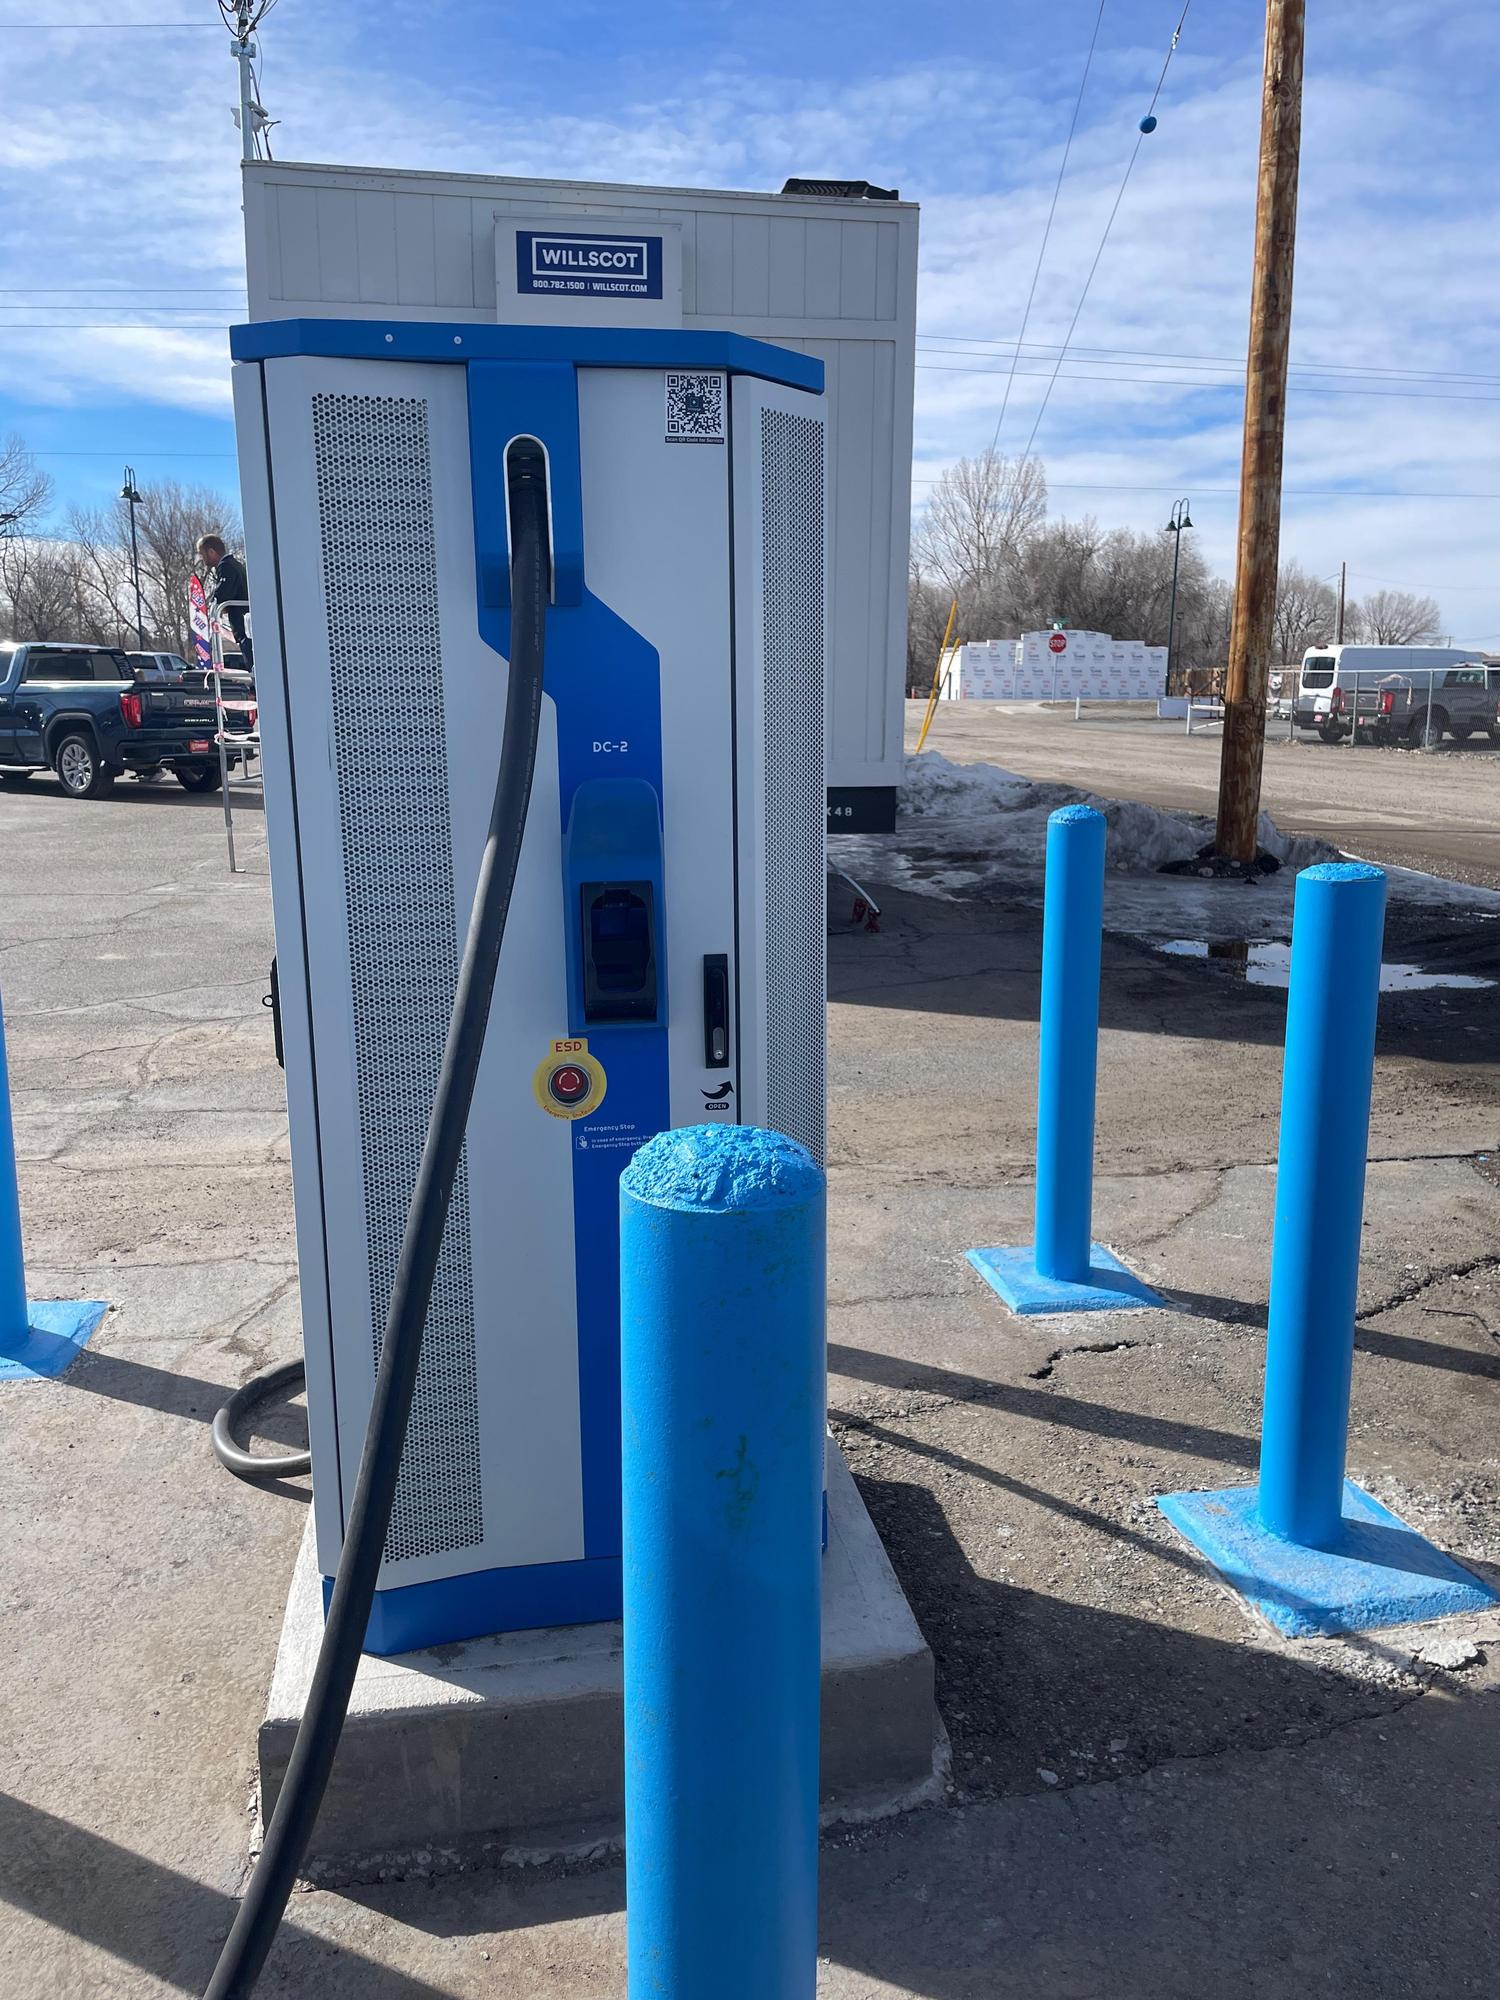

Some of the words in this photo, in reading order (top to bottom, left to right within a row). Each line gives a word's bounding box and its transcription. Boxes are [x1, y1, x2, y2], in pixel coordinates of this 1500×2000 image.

[542, 249, 638, 268] WILLSCOT
[532, 279, 585, 290] 800.782.1500
[592, 282, 648, 293] WILLSCOT.COM
[1049, 639, 1066, 648] STOP
[592, 741, 628, 753] DC-2
[555, 1041, 582, 1053] ESD
[583, 1125, 619, 1133] Emergency
